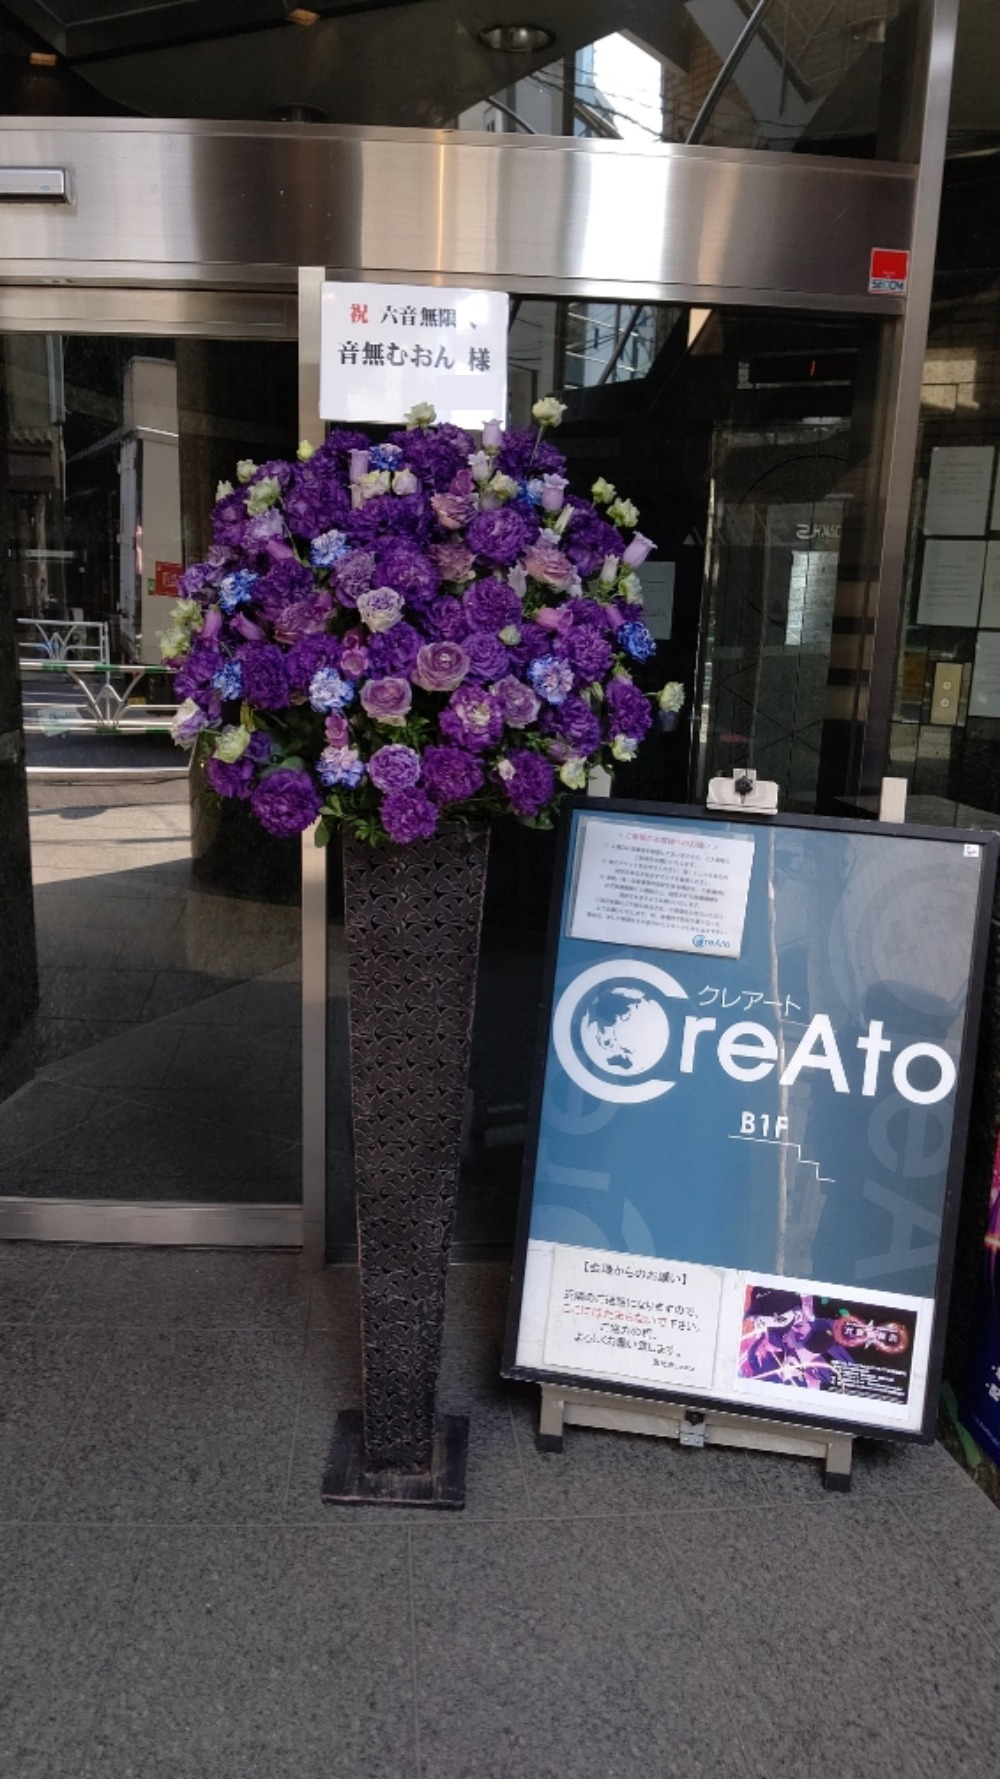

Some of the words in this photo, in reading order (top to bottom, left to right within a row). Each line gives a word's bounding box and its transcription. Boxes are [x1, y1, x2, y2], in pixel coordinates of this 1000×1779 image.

[350, 303, 369, 324] 祝
[338, 340, 455, 370] 音無むおん
[469, 347, 491, 372] 様
[697, 985, 801, 1017] クレアート
[553, 958, 957, 1104] CreAto
[740, 1111, 790, 1140] B1F
